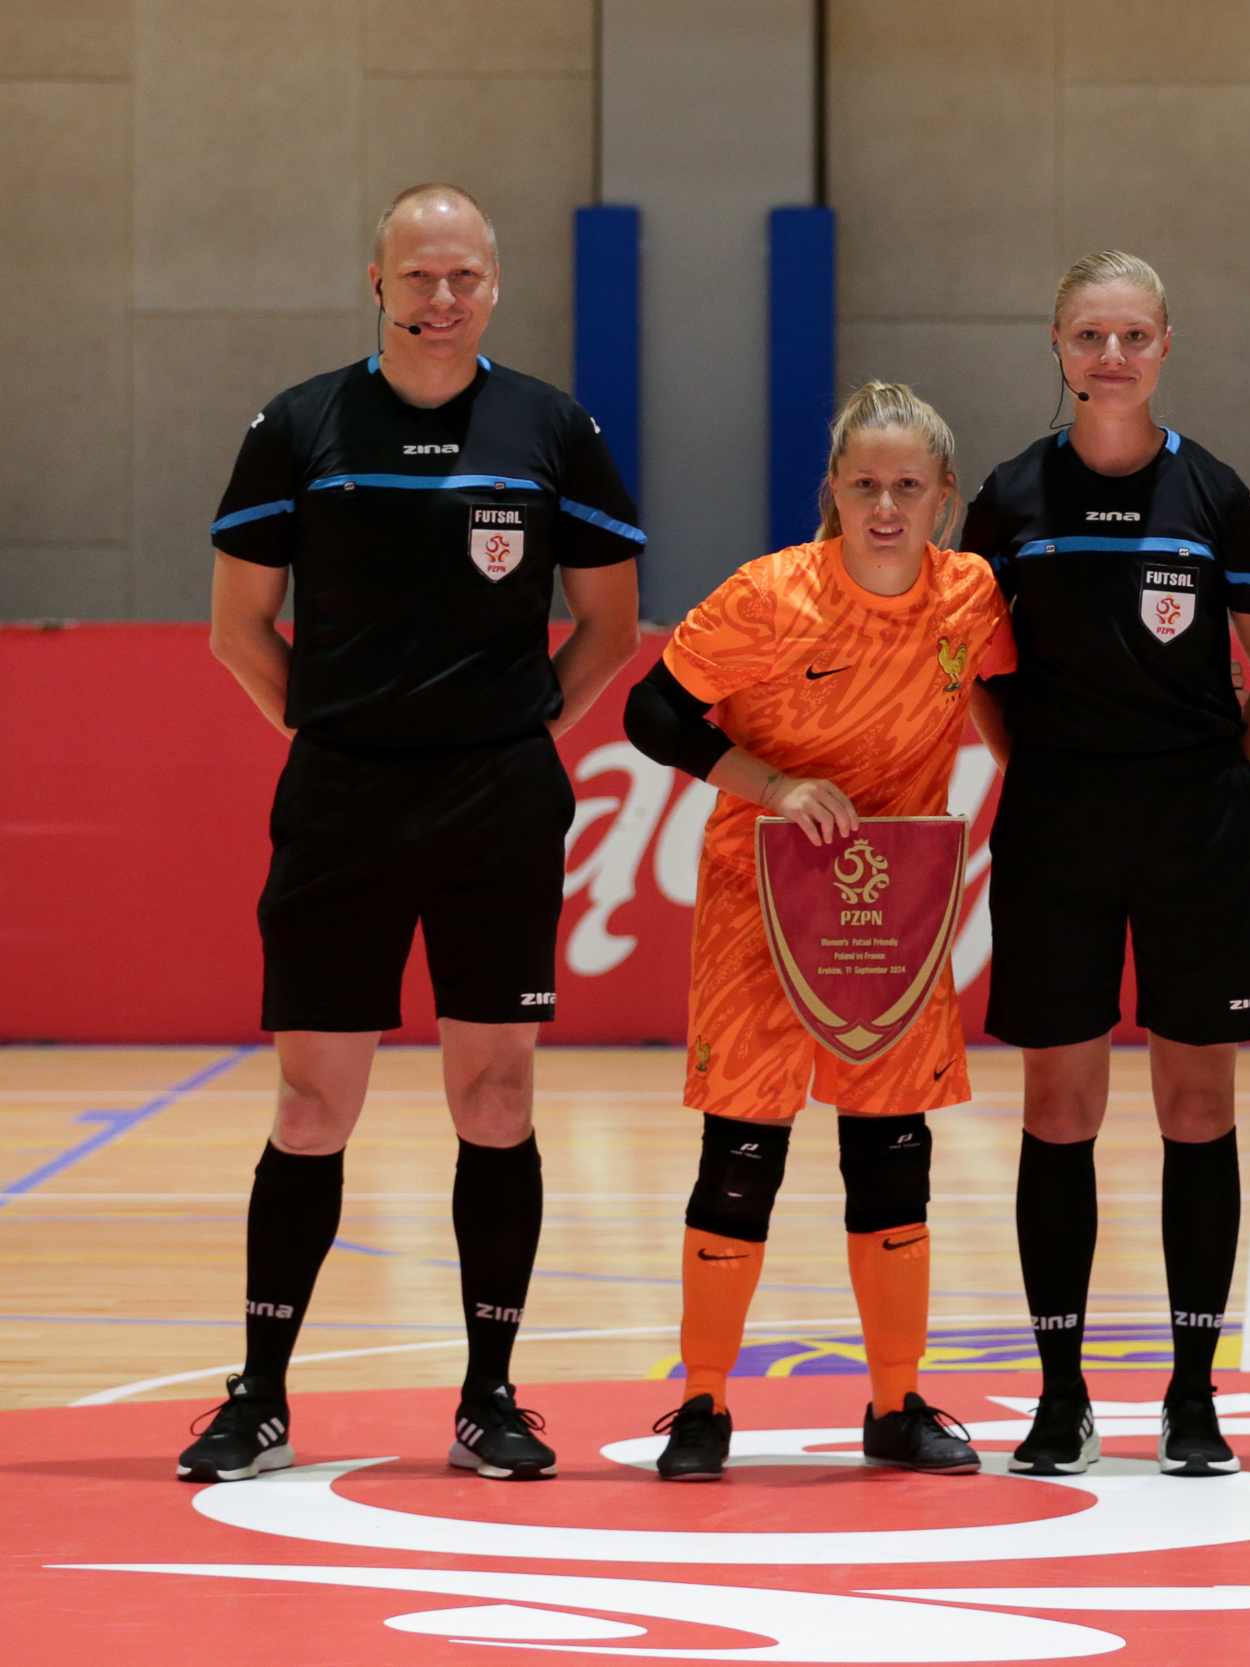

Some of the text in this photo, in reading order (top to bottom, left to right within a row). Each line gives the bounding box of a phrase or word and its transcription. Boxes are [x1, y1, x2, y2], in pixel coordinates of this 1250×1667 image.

[402, 444, 460, 455] zina
[474, 510, 523, 524] FUTSAL
[1085, 511, 1141, 522] zina
[487, 565, 506, 573] PZPN
[1145, 570, 1194, 587] FUTSAL
[1156, 626, 1175, 635] PZPN
[840, 910, 883, 926] PZPN
[852, 938, 872, 947] Futsal
[873, 937, 899, 948] Friendly
[834, 951, 855, 960] Poland
[864, 951, 886, 960] France
[854, 965, 888, 975] September
[890, 965, 906, 974] 2024
[246, 1300, 295, 1319] ina
